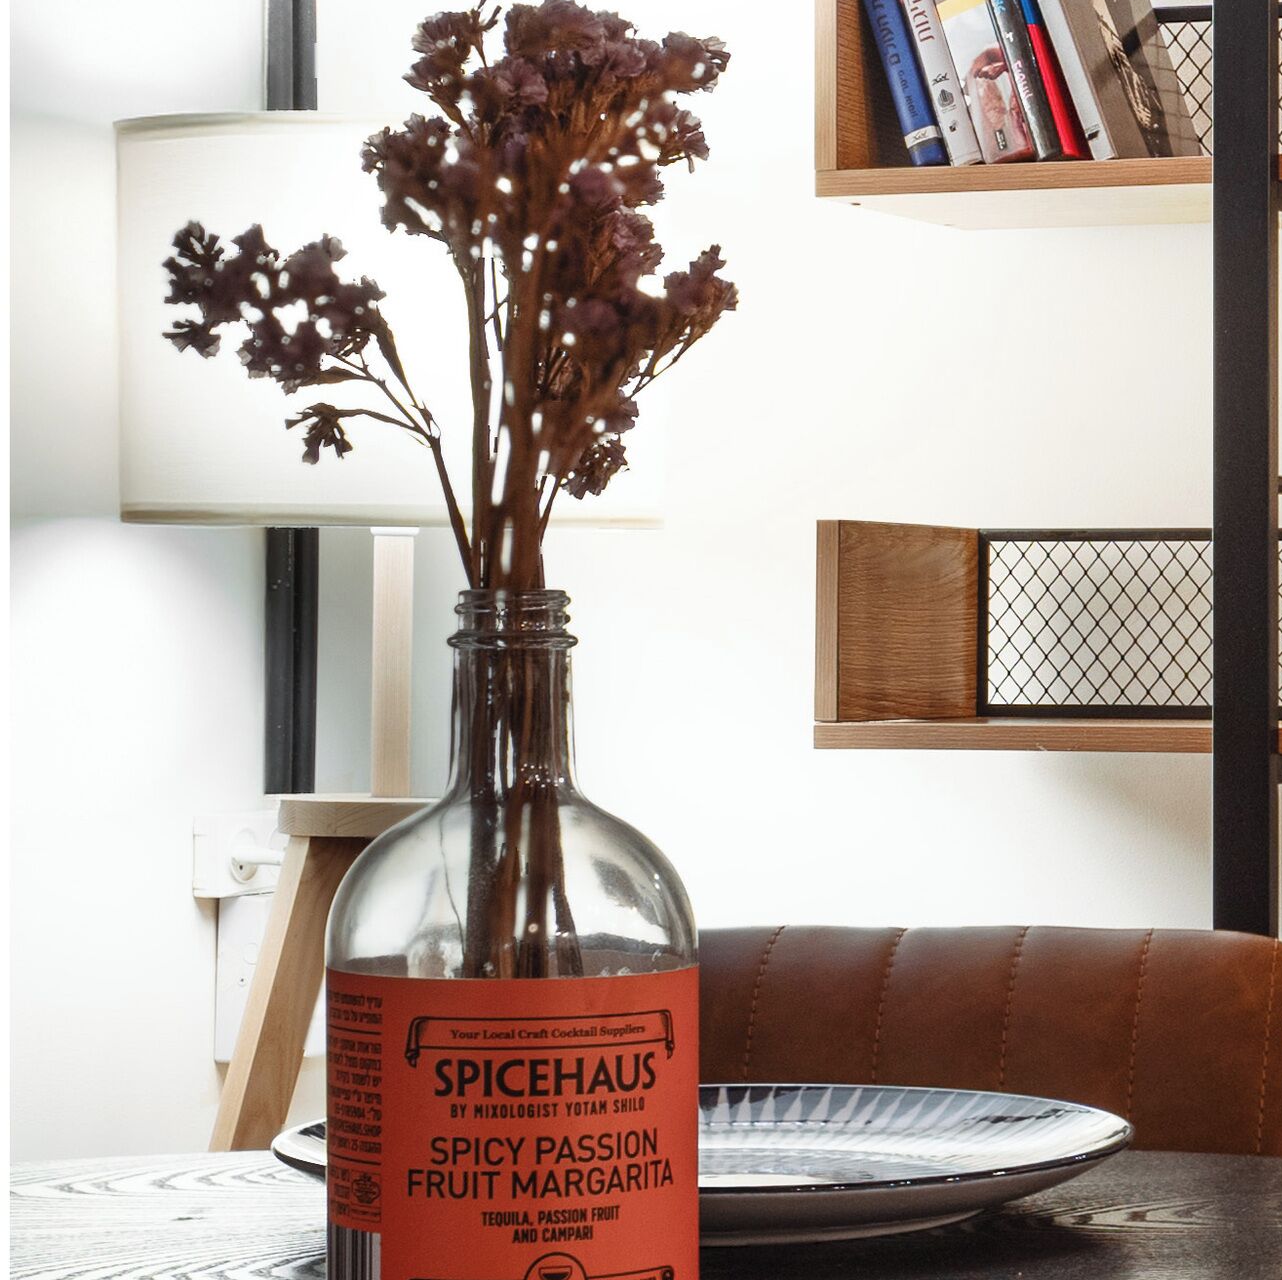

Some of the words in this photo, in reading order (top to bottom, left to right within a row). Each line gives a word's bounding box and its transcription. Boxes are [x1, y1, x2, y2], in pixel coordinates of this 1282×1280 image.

[874, 14, 904, 66] העולם
[450, 1028, 480, 1040] Your
[482, 1028, 516, 1040] Local
[518, 1027, 549, 1040] Craft
[551, 1025, 597, 1039] Cocktail
[599, 1023, 646, 1037] Suppliers
[434, 1051, 657, 1099] SPICEHAUS
[450, 1104, 466, 1119] BY
[473, 1102, 558, 1119] MIXOLOGIST
[564, 1099, 607, 1116] YOTAM
[613, 1096, 645, 1113] SHILO
[430, 1135, 527, 1166] SPICY
[536, 1128, 658, 1164] PASSION
[407, 1169, 500, 1200] FRUIT
[512, 1158, 674, 1199] MARGARITA
[481, 1210, 534, 1227] TEQUILA,
[538, 1208, 587, 1225] PASSION
[591, 1205, 620, 1222] FRUIT
[512, 1227, 538, 1244] AND
[542, 1225, 593, 1242] CAMPARI
